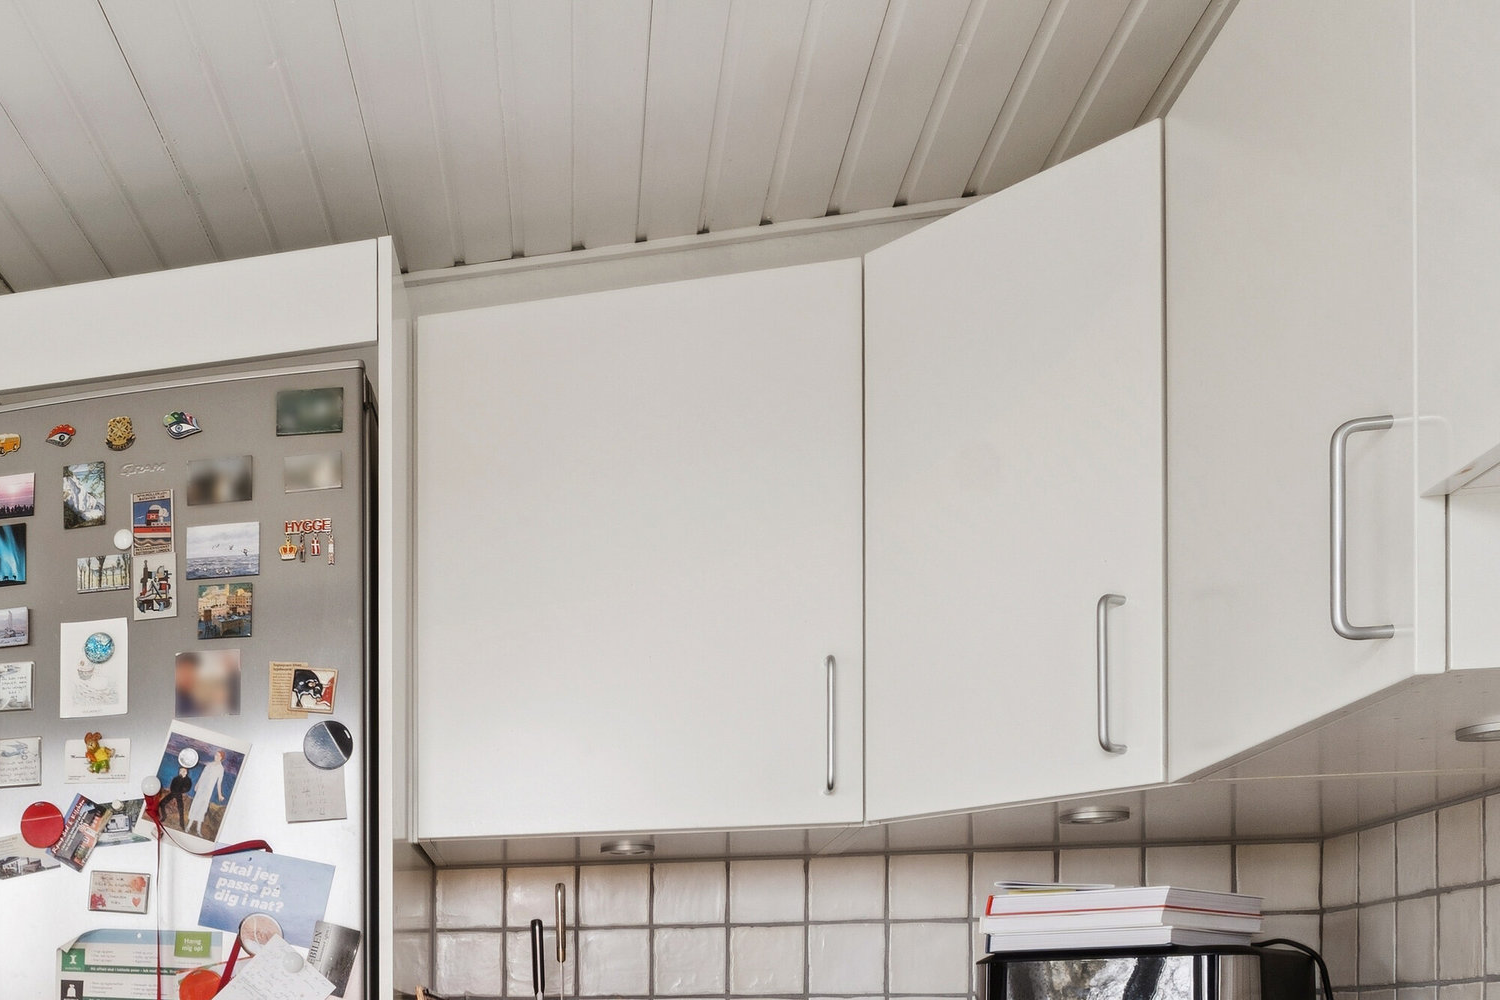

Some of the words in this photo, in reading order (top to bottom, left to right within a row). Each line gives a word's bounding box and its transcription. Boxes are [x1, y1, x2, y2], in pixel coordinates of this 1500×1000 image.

[285, 518, 331, 533] HYGGE
[220, 860, 252, 877] Skal
[253, 866, 280, 885] jeg
[216, 877, 258, 894] passe
[260, 885, 280, 898] på
[214, 889, 240, 907] dig
[241, 894, 248, 906] i
[250, 899, 284, 914] nat?
